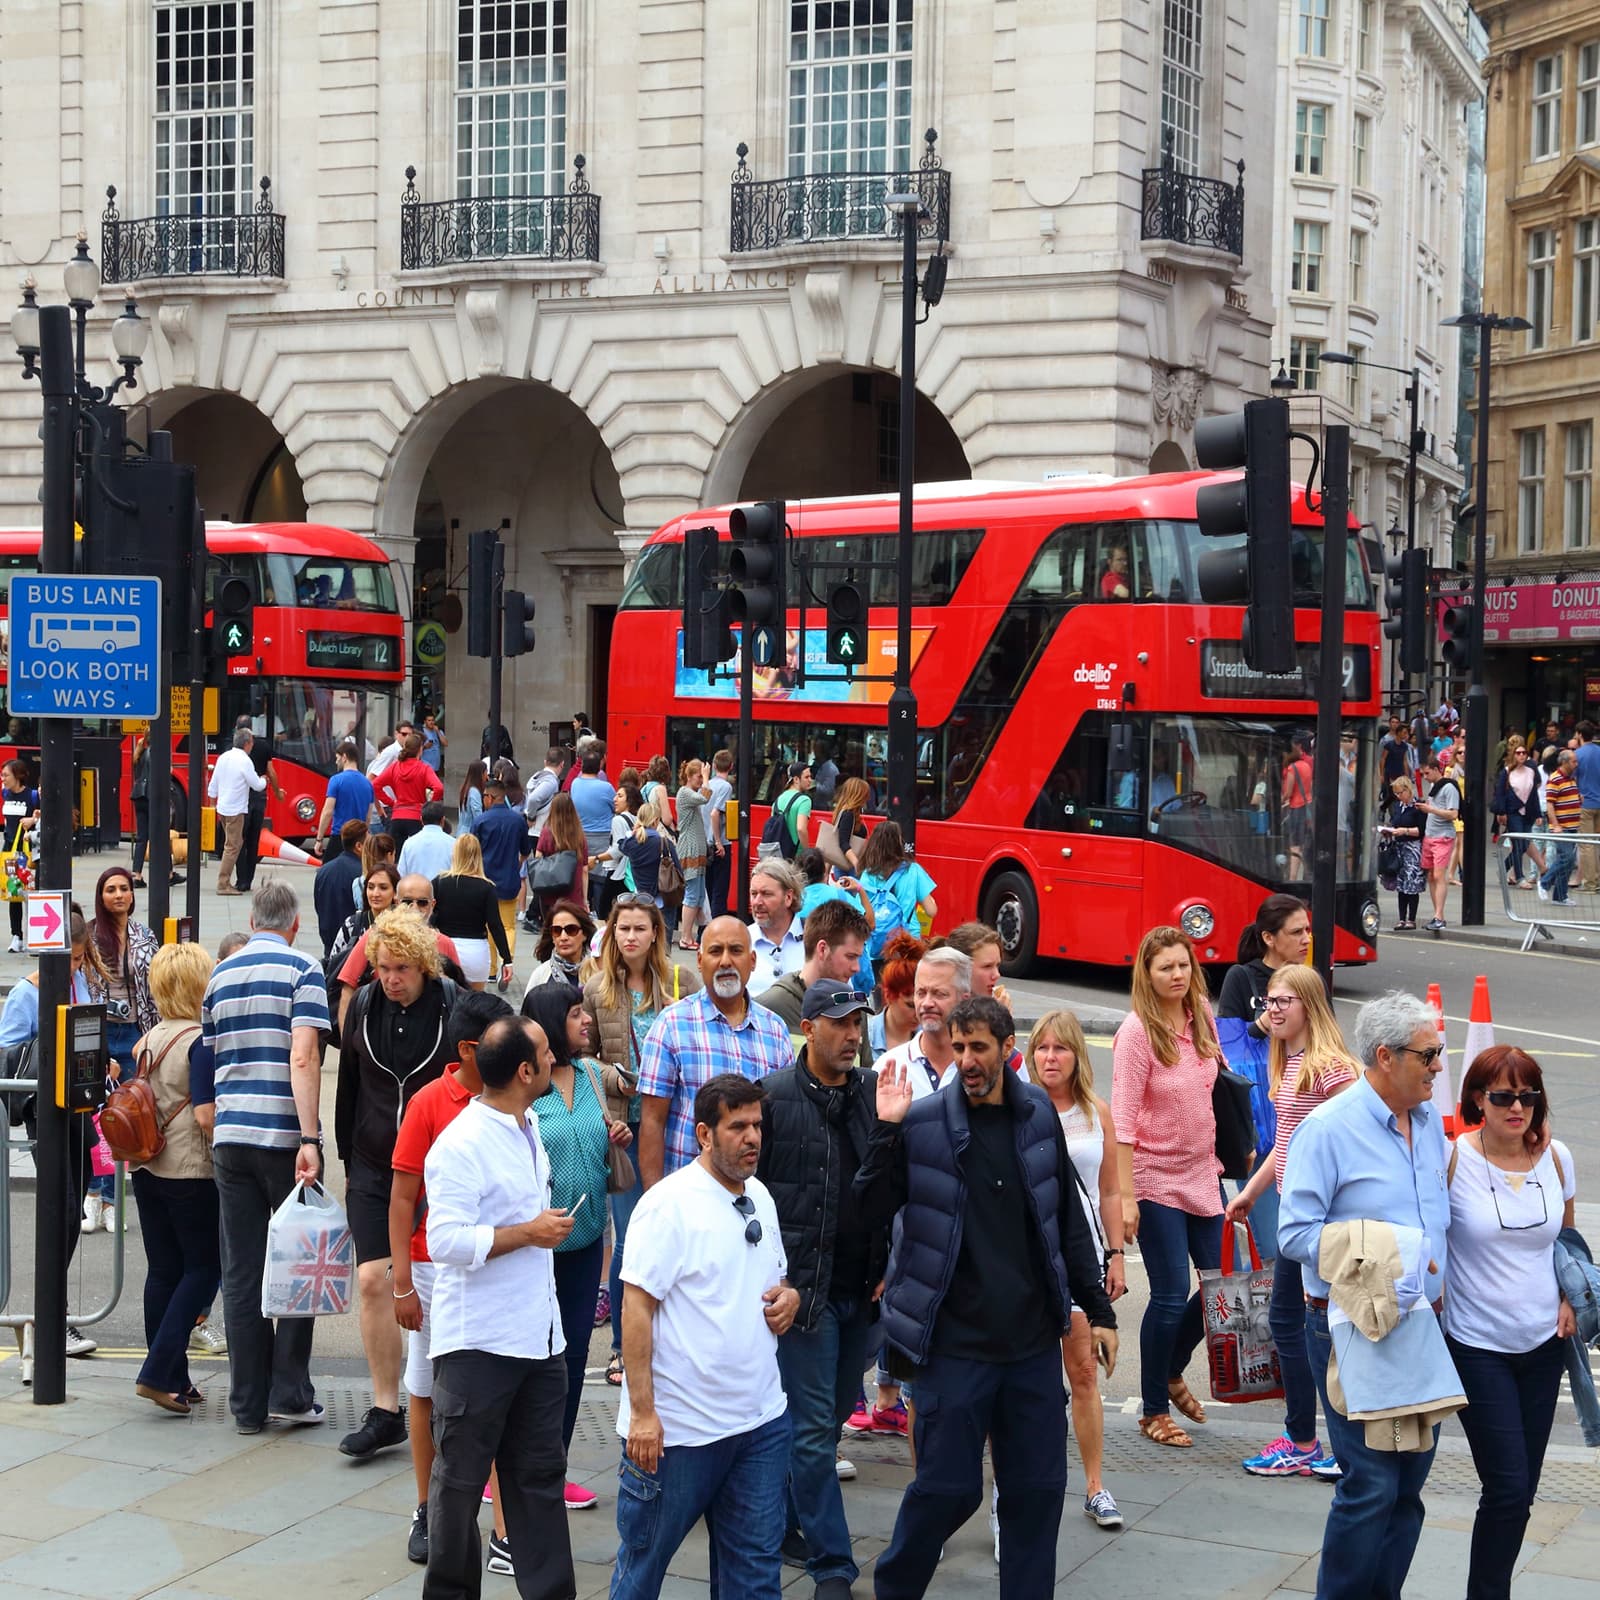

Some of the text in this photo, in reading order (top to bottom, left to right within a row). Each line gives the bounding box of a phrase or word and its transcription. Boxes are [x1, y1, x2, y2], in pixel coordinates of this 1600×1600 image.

[357, 286, 460, 307] COUNTY
[531, 279, 591, 298] FIRE
[652, 270, 797, 294] ALLIANCE
[28, 585, 141, 606] BUS LANE
[310, 640, 363, 657] Dulwich Library
[375, 641, 388, 663] 12
[19, 660, 149, 681] LOOK BOTH
[1074, 663, 1111, 682] abellio
[53, 689, 116, 708] WAYS
[901, 710, 907, 718] 2
